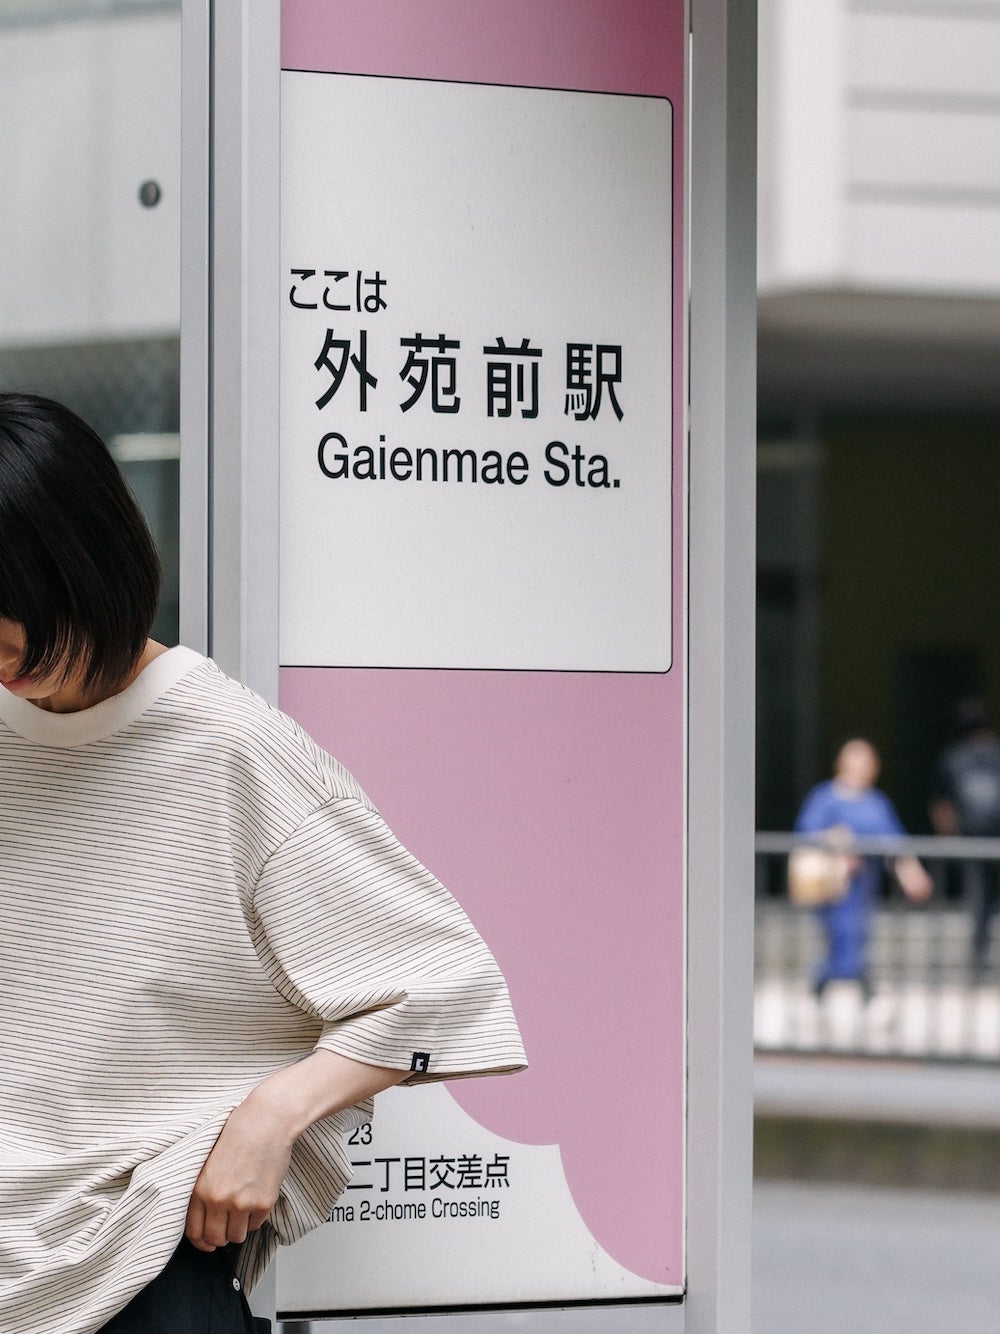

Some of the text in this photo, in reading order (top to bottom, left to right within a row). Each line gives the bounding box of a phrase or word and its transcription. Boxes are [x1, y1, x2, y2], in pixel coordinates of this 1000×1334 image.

[289, 268, 388, 313] ここは
[313, 328, 625, 422] 外苑前駅
[317, 432, 621, 489] Gaienmae Sta.
[343, 1153, 510, 1194] 二丁目交差点
[359, 1199, 426, 1221] 2-chome
[431, 1196, 500, 1220] Crossing
